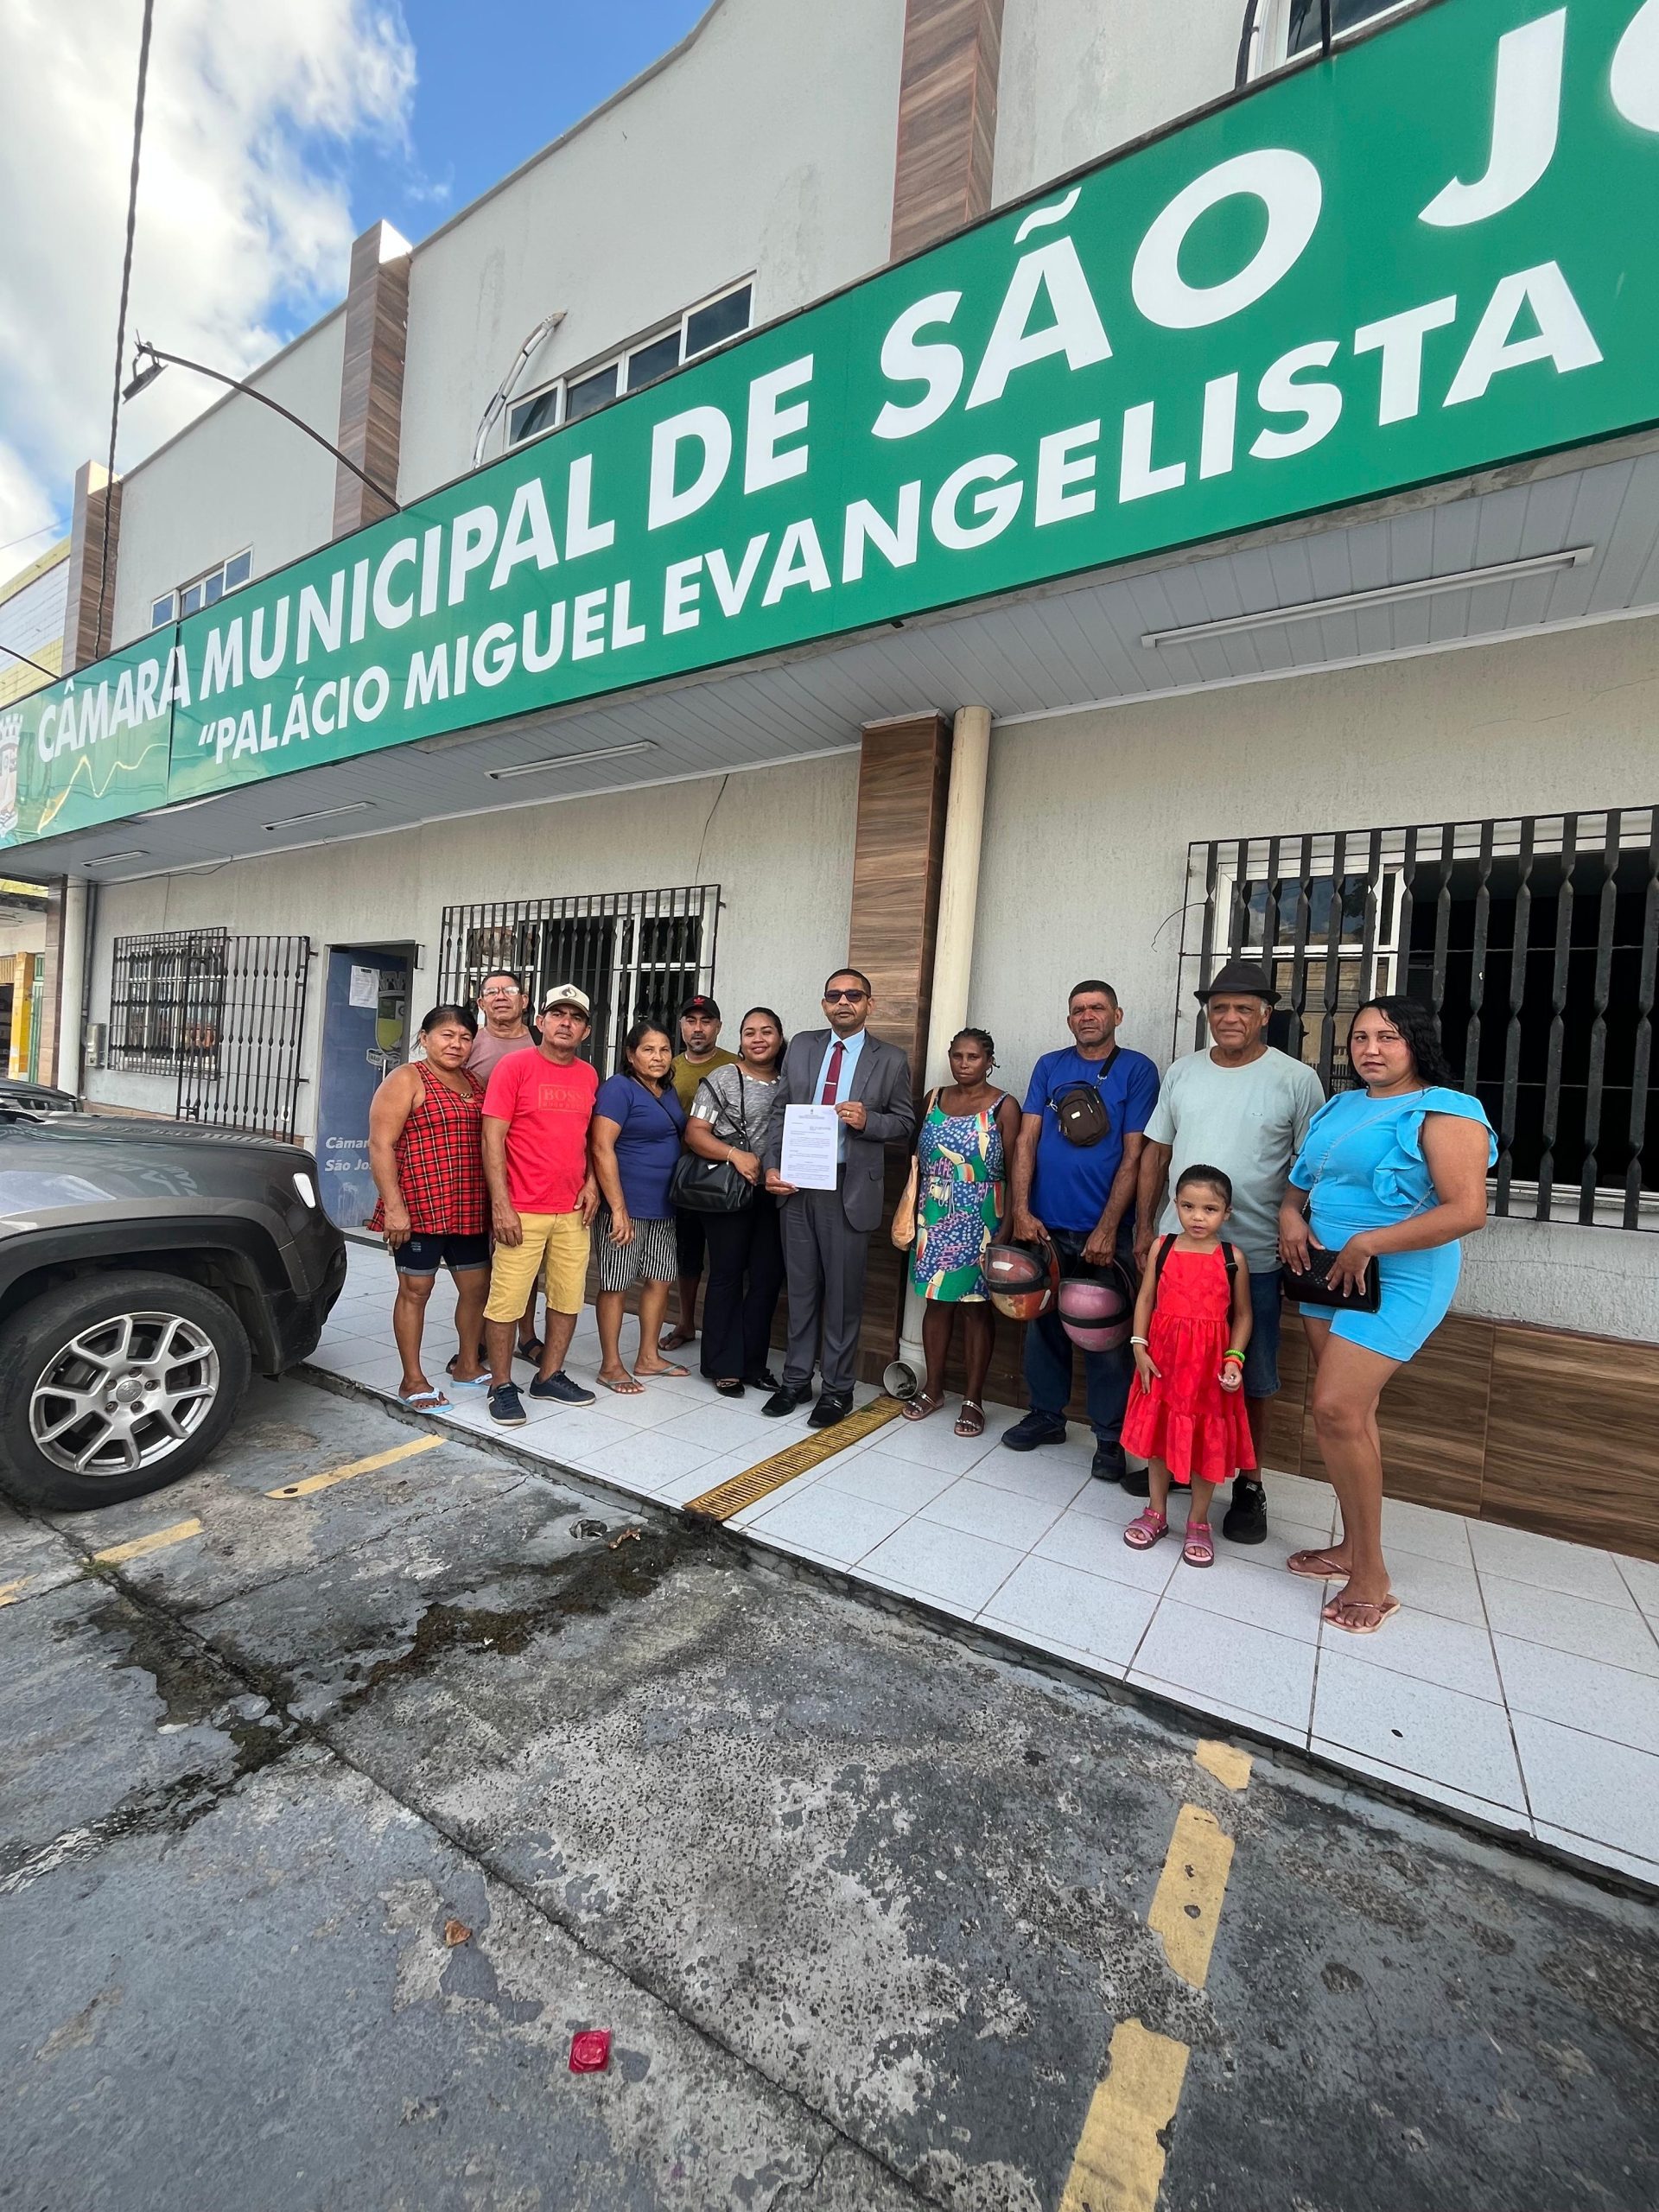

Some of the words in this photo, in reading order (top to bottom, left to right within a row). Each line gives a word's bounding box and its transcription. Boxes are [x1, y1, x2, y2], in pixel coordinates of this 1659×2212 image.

[37, 645, 191, 762] CÂMARA
[199, 454, 615, 701] MUNICIPAL
[648, 353, 814, 531] DE
[871, 149, 1322, 439] SÃO
[404, 581, 645, 709] MIGUEL
[663, 261, 1604, 635] EVANGELISTA
[325, 1160, 351, 1171] São
[354, 1159, 372, 1171] Jo
[543, 1089, 583, 1101] BOSS
